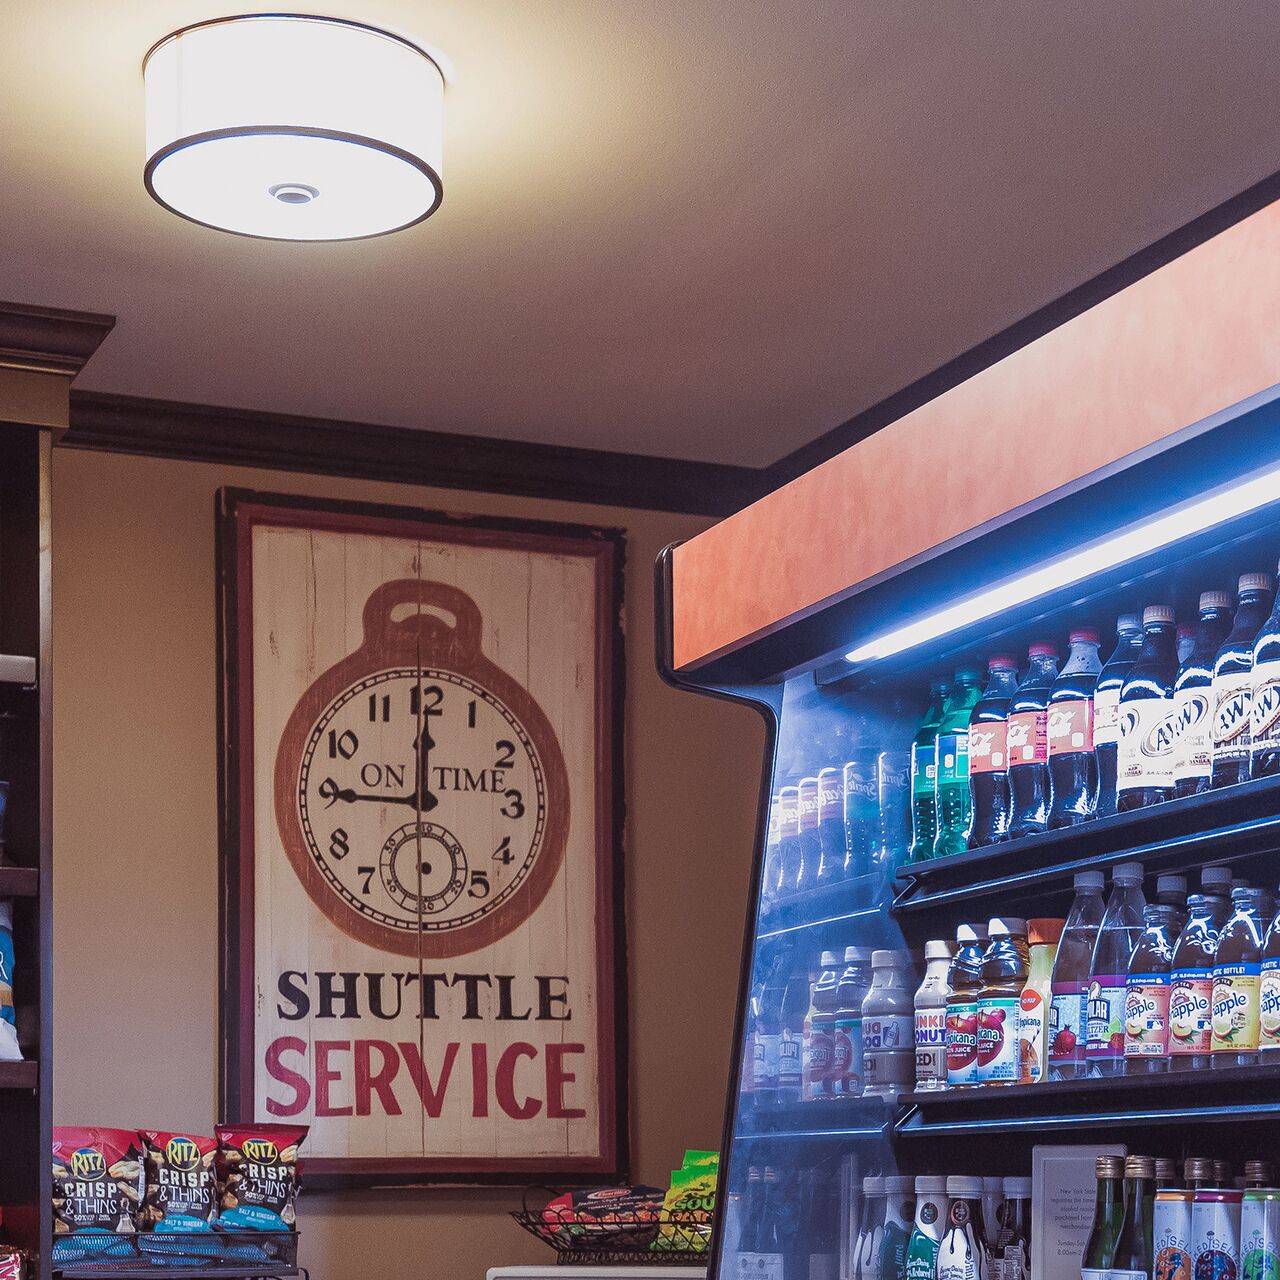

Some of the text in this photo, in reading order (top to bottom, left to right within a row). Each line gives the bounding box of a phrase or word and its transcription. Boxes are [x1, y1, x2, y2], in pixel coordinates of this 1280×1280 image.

[368, 693, 391, 722] 11
[410, 685, 445, 716] 12
[467, 700, 476, 728] 1
[328, 728, 359, 759] 10
[494, 740, 516, 769] 2
[319, 777, 339, 809] 9
[360, 764, 507, 794] ON TIME
[500, 790, 525, 819] 3
[328, 828, 350, 860] 8
[491, 836, 515, 866] 4
[357, 867, 376, 895] 7
[467, 870, 490, 899] 5
[1223, 966, 1245, 975] BOTTLE!
[276, 969, 573, 1022] SHUTTLE
[264, 1035, 587, 1120] SERVICE
[71, 1152, 105, 1176] RITZ
[167, 1140, 199, 1165] RITZ
[243, 1140, 277, 1161] RITZ
[64, 1182, 118, 1198] CRISP
[159, 1169, 210, 1187] CRISP
[239, 1180, 285, 1198] & THINS
[65, 1199, 118, 1215] & THINS
[159, 1186, 210, 1204] & THINS
[164, 1219, 177, 1227] SALT
[182, 1220, 204, 1228] VINEGAR
[238, 1207, 250, 1215] SALT
[254, 1211, 276, 1222] VINEGAR
